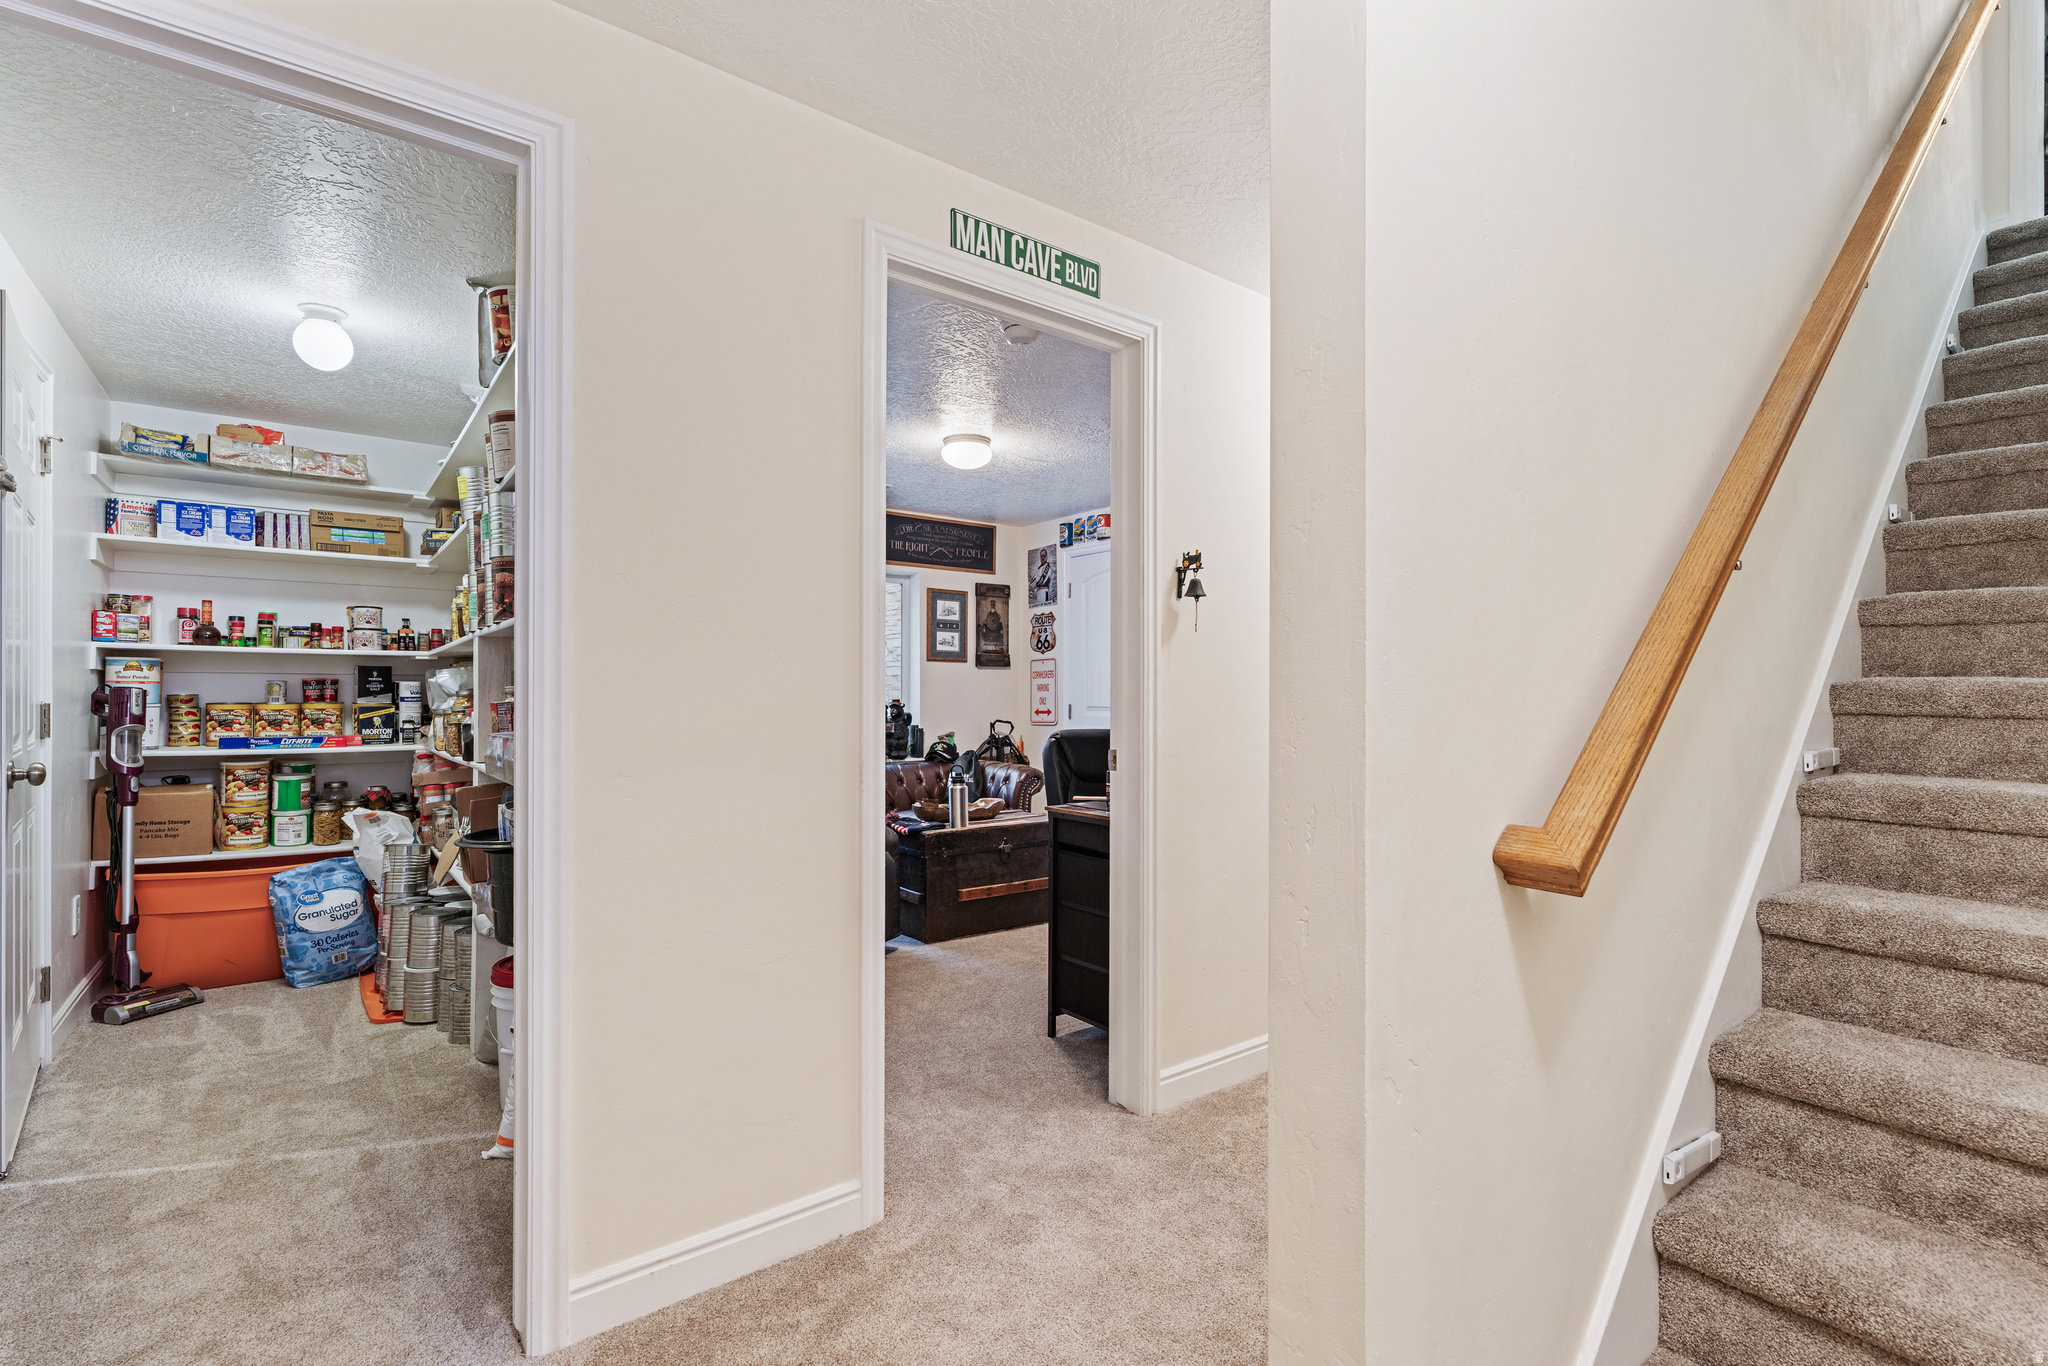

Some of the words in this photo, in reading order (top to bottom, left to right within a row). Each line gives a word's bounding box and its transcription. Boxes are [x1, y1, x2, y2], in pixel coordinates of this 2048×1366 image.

[956, 212, 1005, 265] MAN
[1011, 234, 1062, 285] CAVE
[1065, 258, 1097, 292] BLVD
[169, 450, 197, 459] FLAVOR
[121, 503, 156, 512] American
[889, 539, 905, 550] THE
[905, 541, 930, 552] RIGHT
[955, 547, 989, 559] PEOPLE
[1034, 616, 1051, 625] ROUTE
[1036, 634, 1050, 650] 66
[1036, 683, 1050, 692] PARKING
[1039, 696, 1047, 706] ONLY
[300, 892, 320, 901] Great
[298, 899, 358, 921] Granulated
[330, 908, 359, 922] Sugar
[310, 939, 324, 949] 30
[325, 929, 359, 945] Calories
[330, 939, 356, 952] Serving
